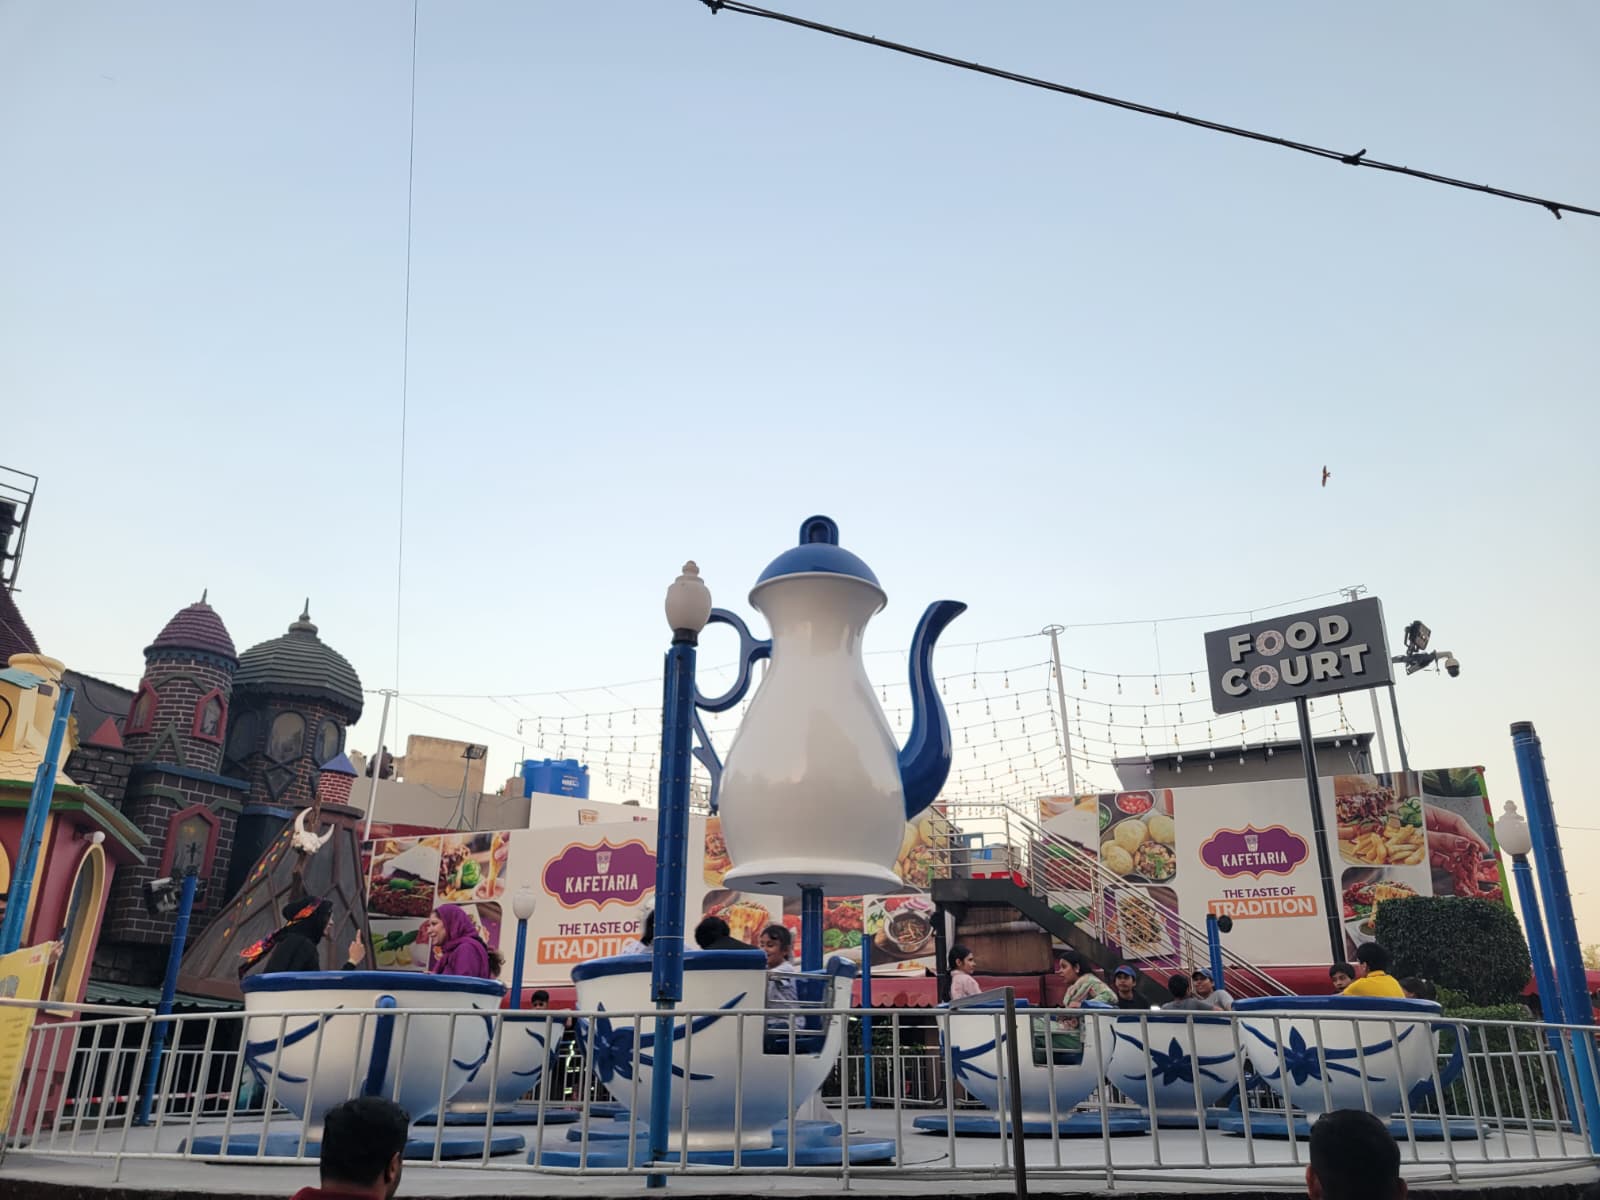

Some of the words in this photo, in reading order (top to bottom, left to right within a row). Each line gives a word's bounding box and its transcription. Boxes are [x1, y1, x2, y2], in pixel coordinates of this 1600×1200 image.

[1229, 615, 1349, 662] FOOD
[1222, 644, 1368, 695] COURT
[1222, 851, 1288, 867] KAFETARIA
[565, 874, 639, 893] KAFETARIA
[1223, 889, 1244, 898] THE
[1245, 887, 1279, 897] TASTE
[1281, 886, 1296, 896] OF
[1211, 898, 1313, 916] TRADITION
[558, 923, 582, 935] THE
[584, 921, 620, 934] TASTE
[623, 920, 641, 933] OF
[542, 937, 638, 960] TRADITI
